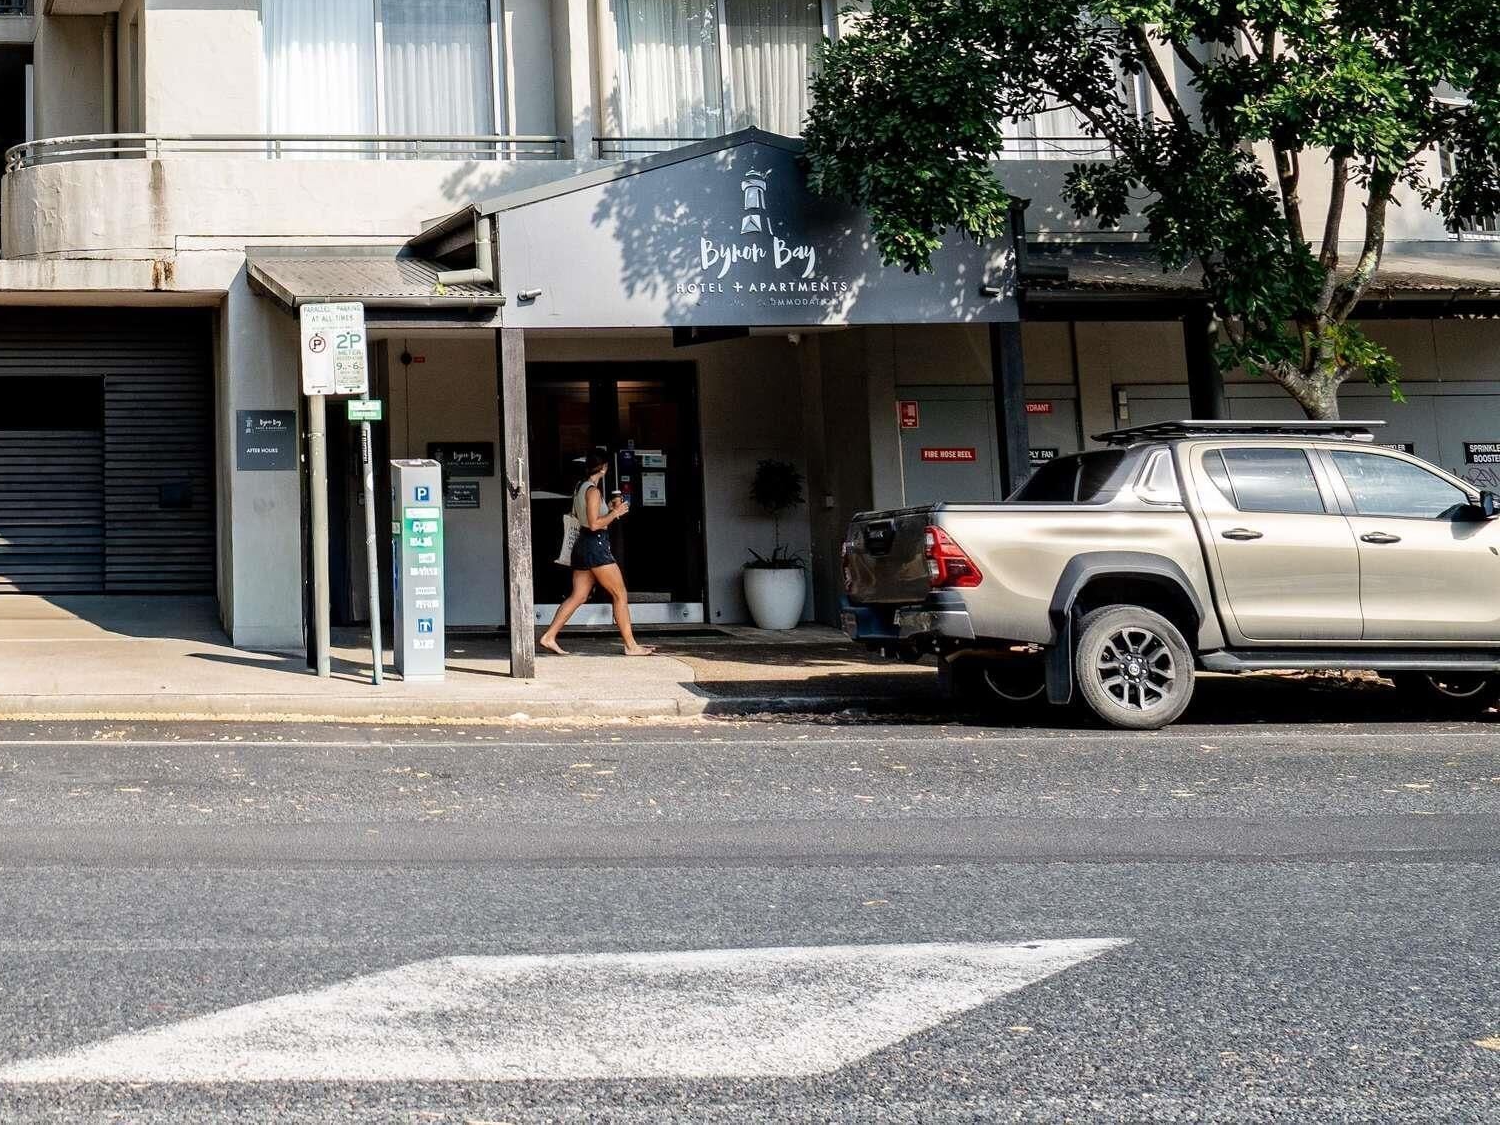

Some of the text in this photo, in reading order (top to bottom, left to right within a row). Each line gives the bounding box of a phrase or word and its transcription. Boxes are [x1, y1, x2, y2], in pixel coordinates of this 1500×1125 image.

[700, 236, 815, 279] Byron Bay
[676, 282, 724, 293] HOTEL
[749, 281, 848, 293] APARTMENTS
[336, 334, 362, 349] 2P
[1469, 444, 1500, 453] SPRINKLE
[924, 450, 973, 458] FIRE HOSE REEL
[1041, 450, 1054, 458] FAN
[1473, 454, 1500, 463] BOOSTE
